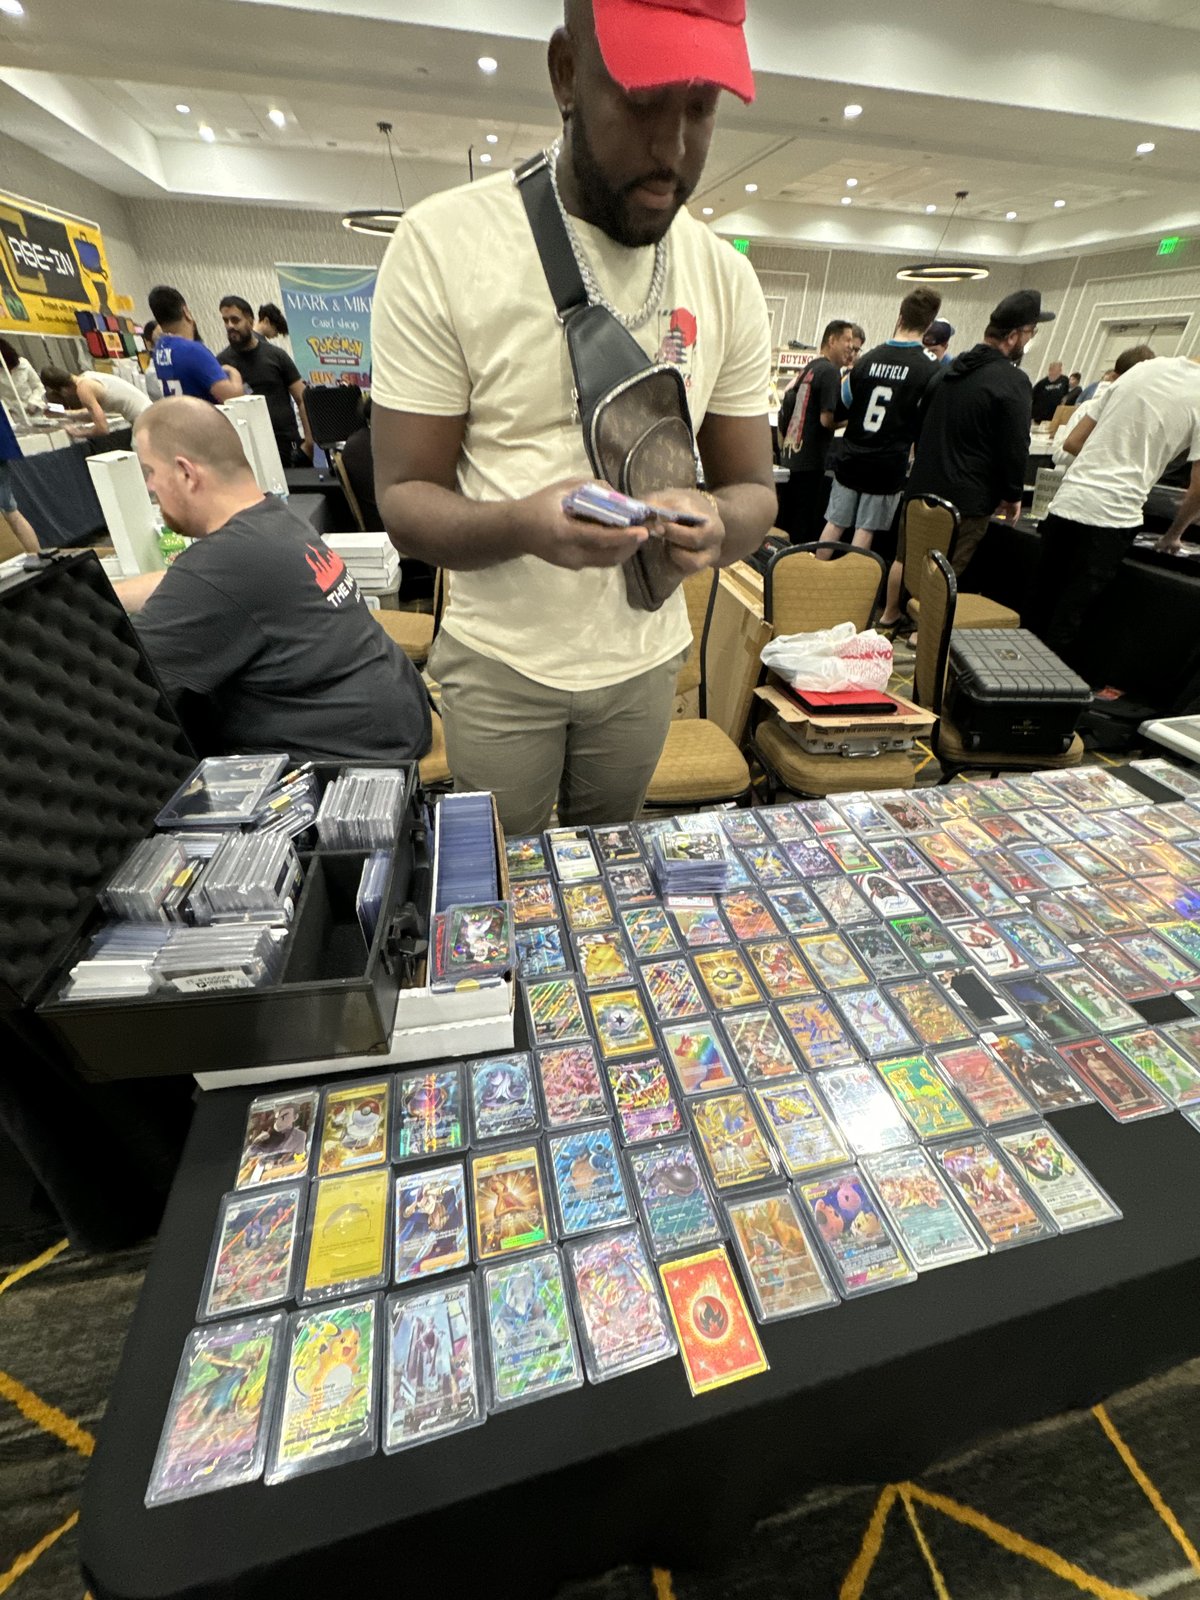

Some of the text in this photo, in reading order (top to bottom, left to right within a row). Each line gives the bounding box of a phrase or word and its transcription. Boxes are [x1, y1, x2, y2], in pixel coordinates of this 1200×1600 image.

[287, 293, 372, 313] MARK & MIK
[311, 316, 360, 331] Card shop
[869, 362, 910, 381] MAYFIELD
[862, 385, 893, 433] 6
[327, 582, 350, 607] THE
